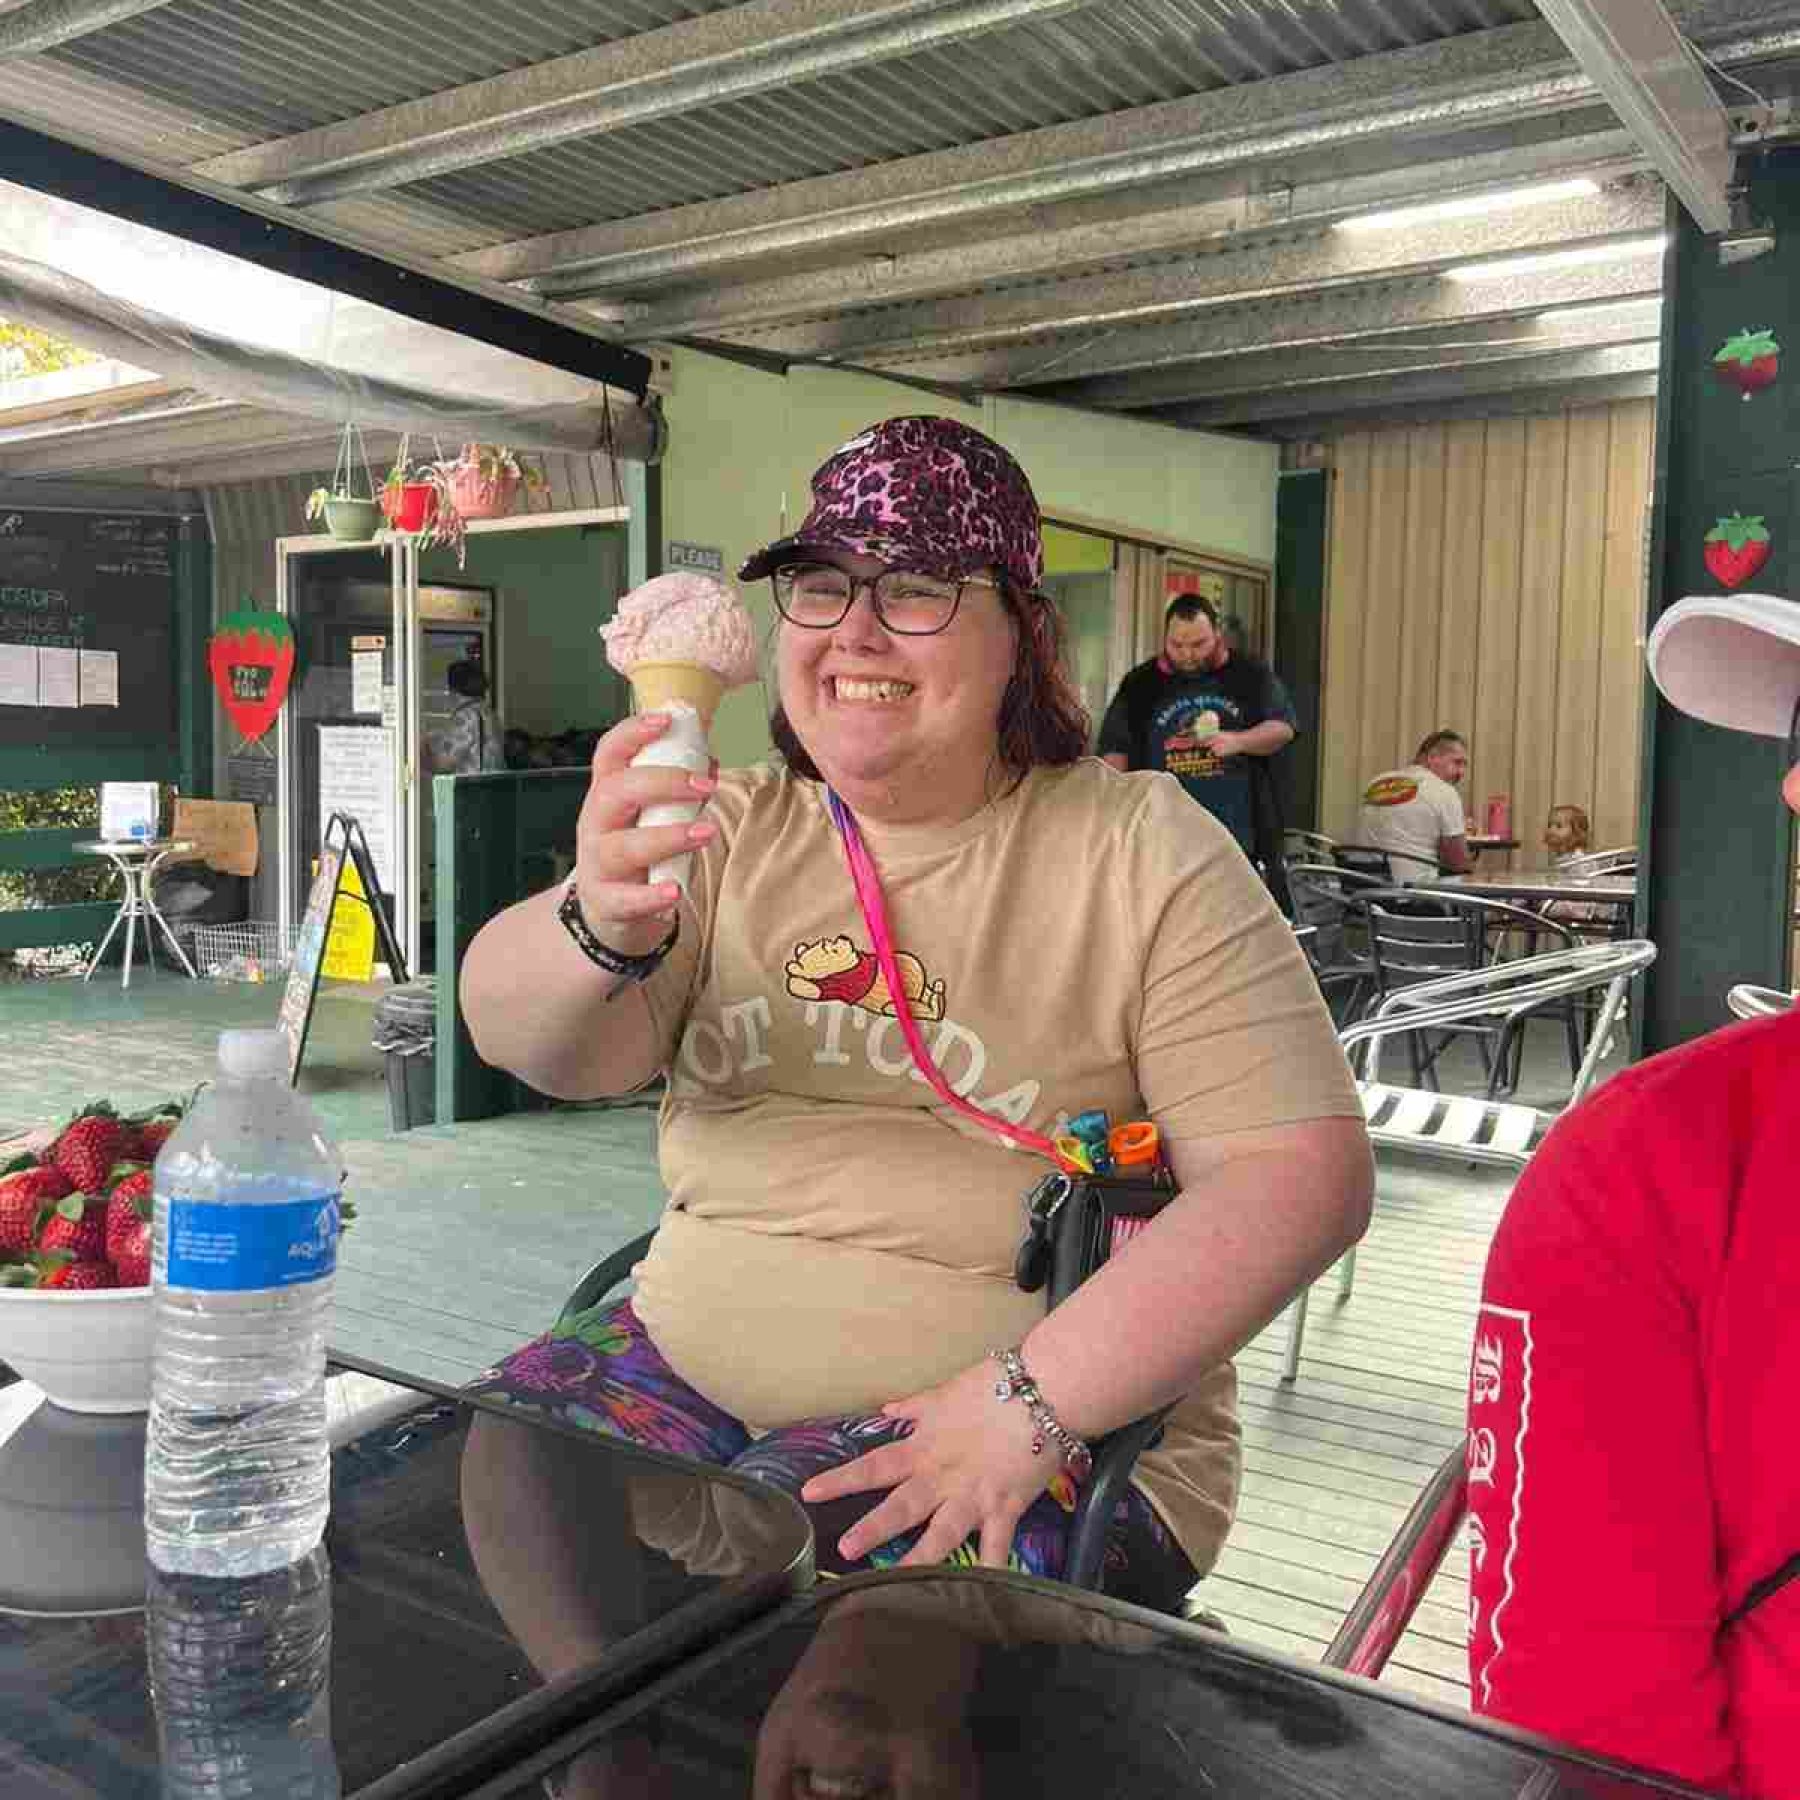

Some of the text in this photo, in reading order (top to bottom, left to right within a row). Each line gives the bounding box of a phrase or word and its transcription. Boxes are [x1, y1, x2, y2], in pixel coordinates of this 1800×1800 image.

[671, 546, 720, 569] PLEASE
[682, 996, 1042, 1149] OT TODA
